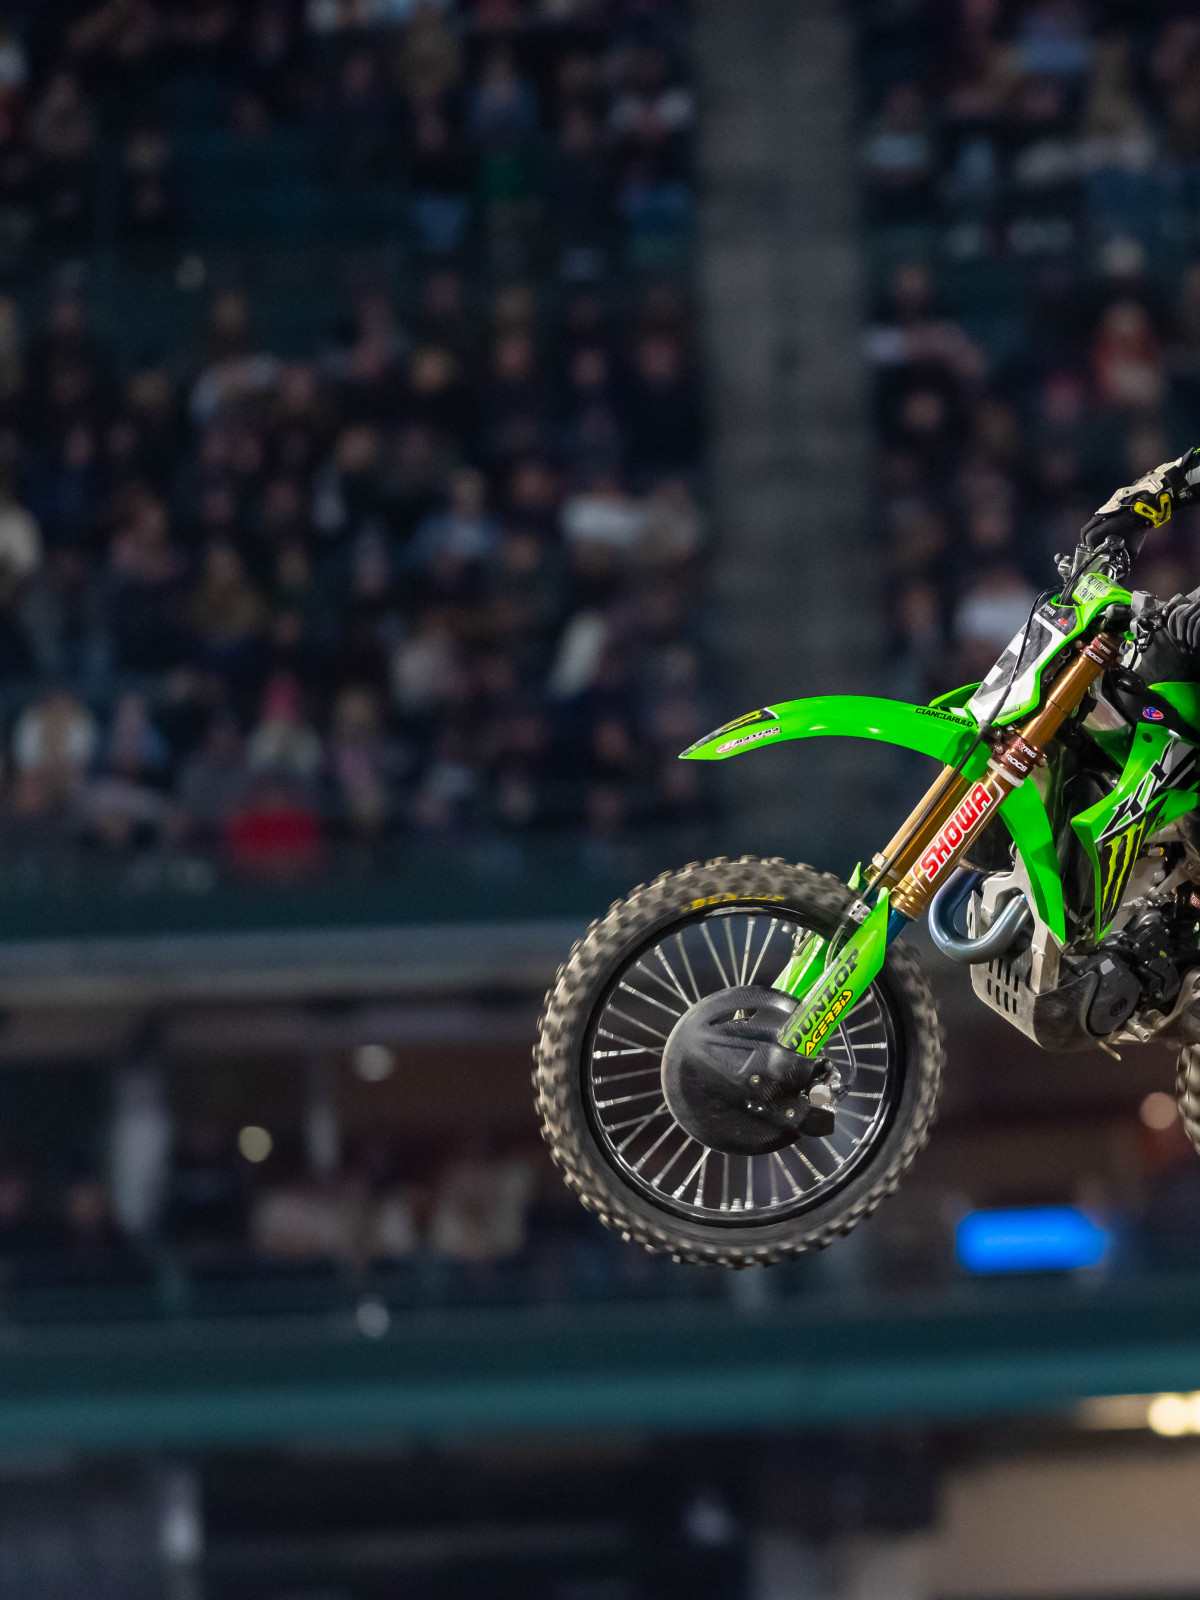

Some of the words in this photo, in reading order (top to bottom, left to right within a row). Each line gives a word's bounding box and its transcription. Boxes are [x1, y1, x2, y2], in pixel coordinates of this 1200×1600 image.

[915, 707, 974, 727] CIANCIARULO
[919, 782, 994, 884] SHOWA
[785, 948, 860, 1052] DUNLOP
